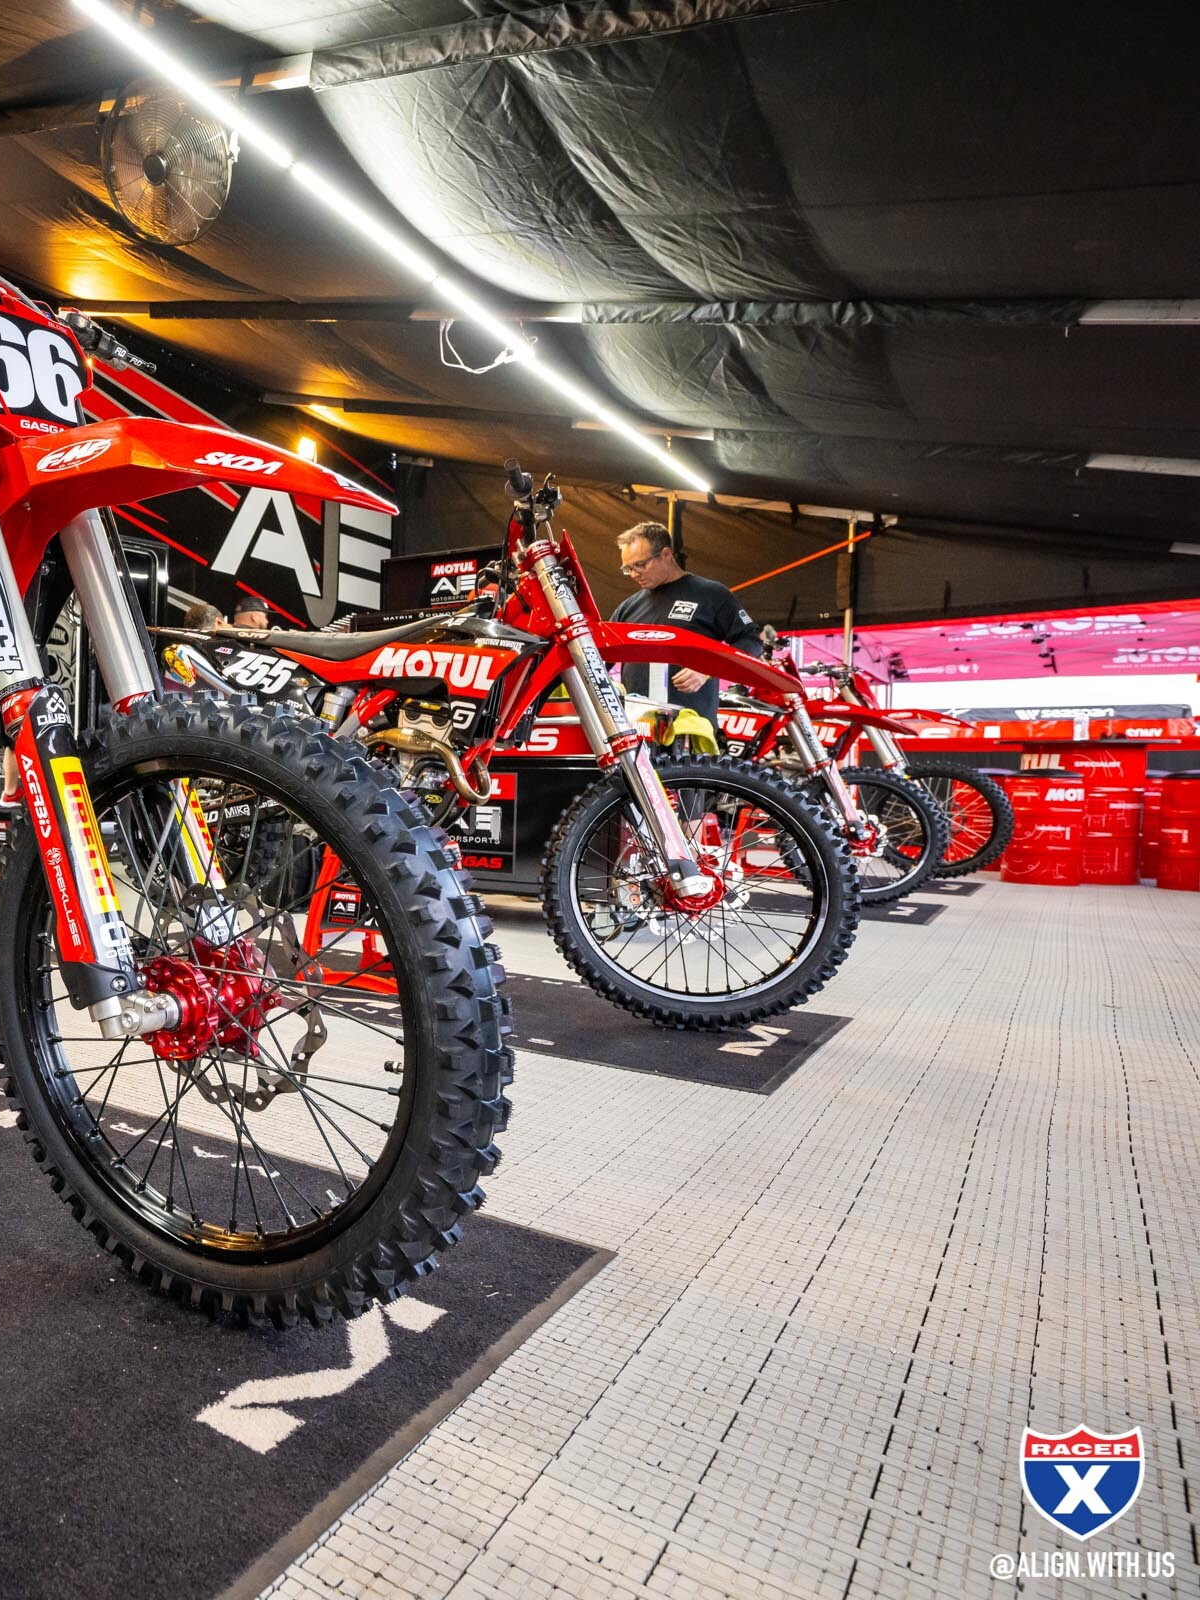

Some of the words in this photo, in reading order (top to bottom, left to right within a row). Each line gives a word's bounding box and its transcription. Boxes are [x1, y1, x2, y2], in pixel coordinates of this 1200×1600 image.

[114, 346, 127, 358] FLO
[194, 451, 285, 476] SKDA
[433, 561, 475, 576] MOTUL
[368, 646, 496, 691] MOTUL
[450, 835, 501, 845] ORSPORTS
[54, 864, 82, 948] REKLUSE
